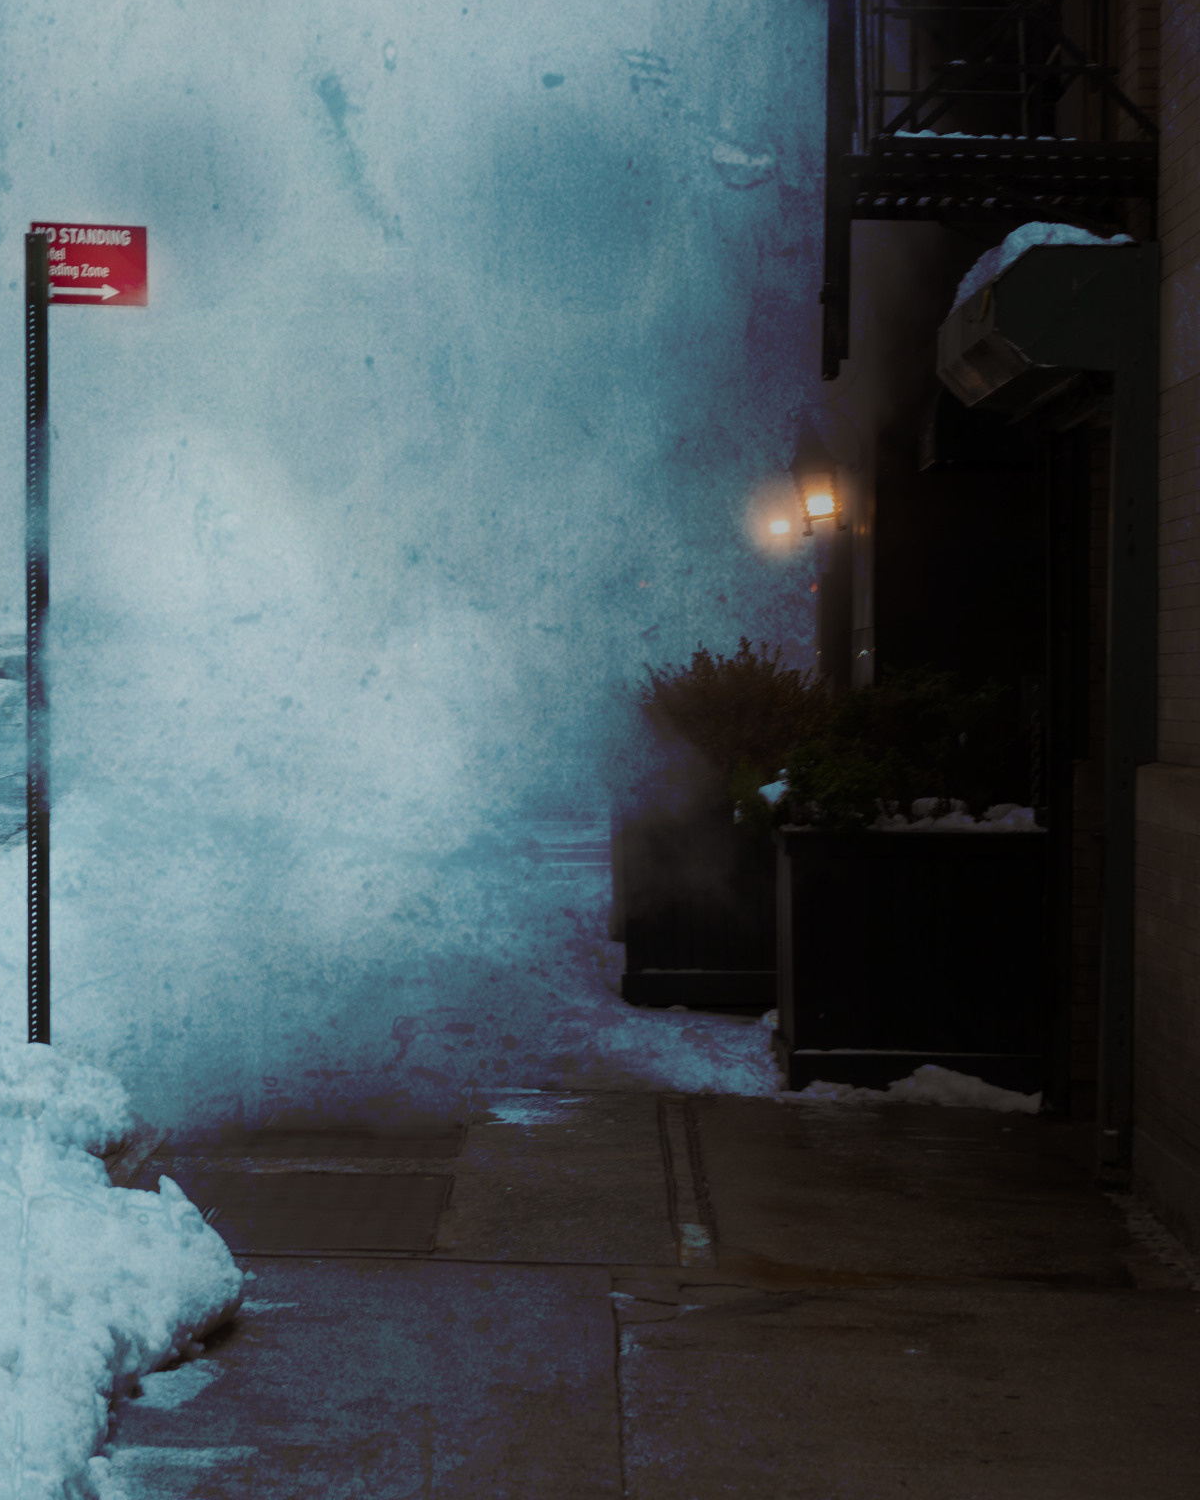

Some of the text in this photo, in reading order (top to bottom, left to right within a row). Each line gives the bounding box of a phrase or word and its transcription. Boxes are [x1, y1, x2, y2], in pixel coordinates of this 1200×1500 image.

[58, 227, 131, 247] STANDING
[48, 263, 110, 279] ading Zone
